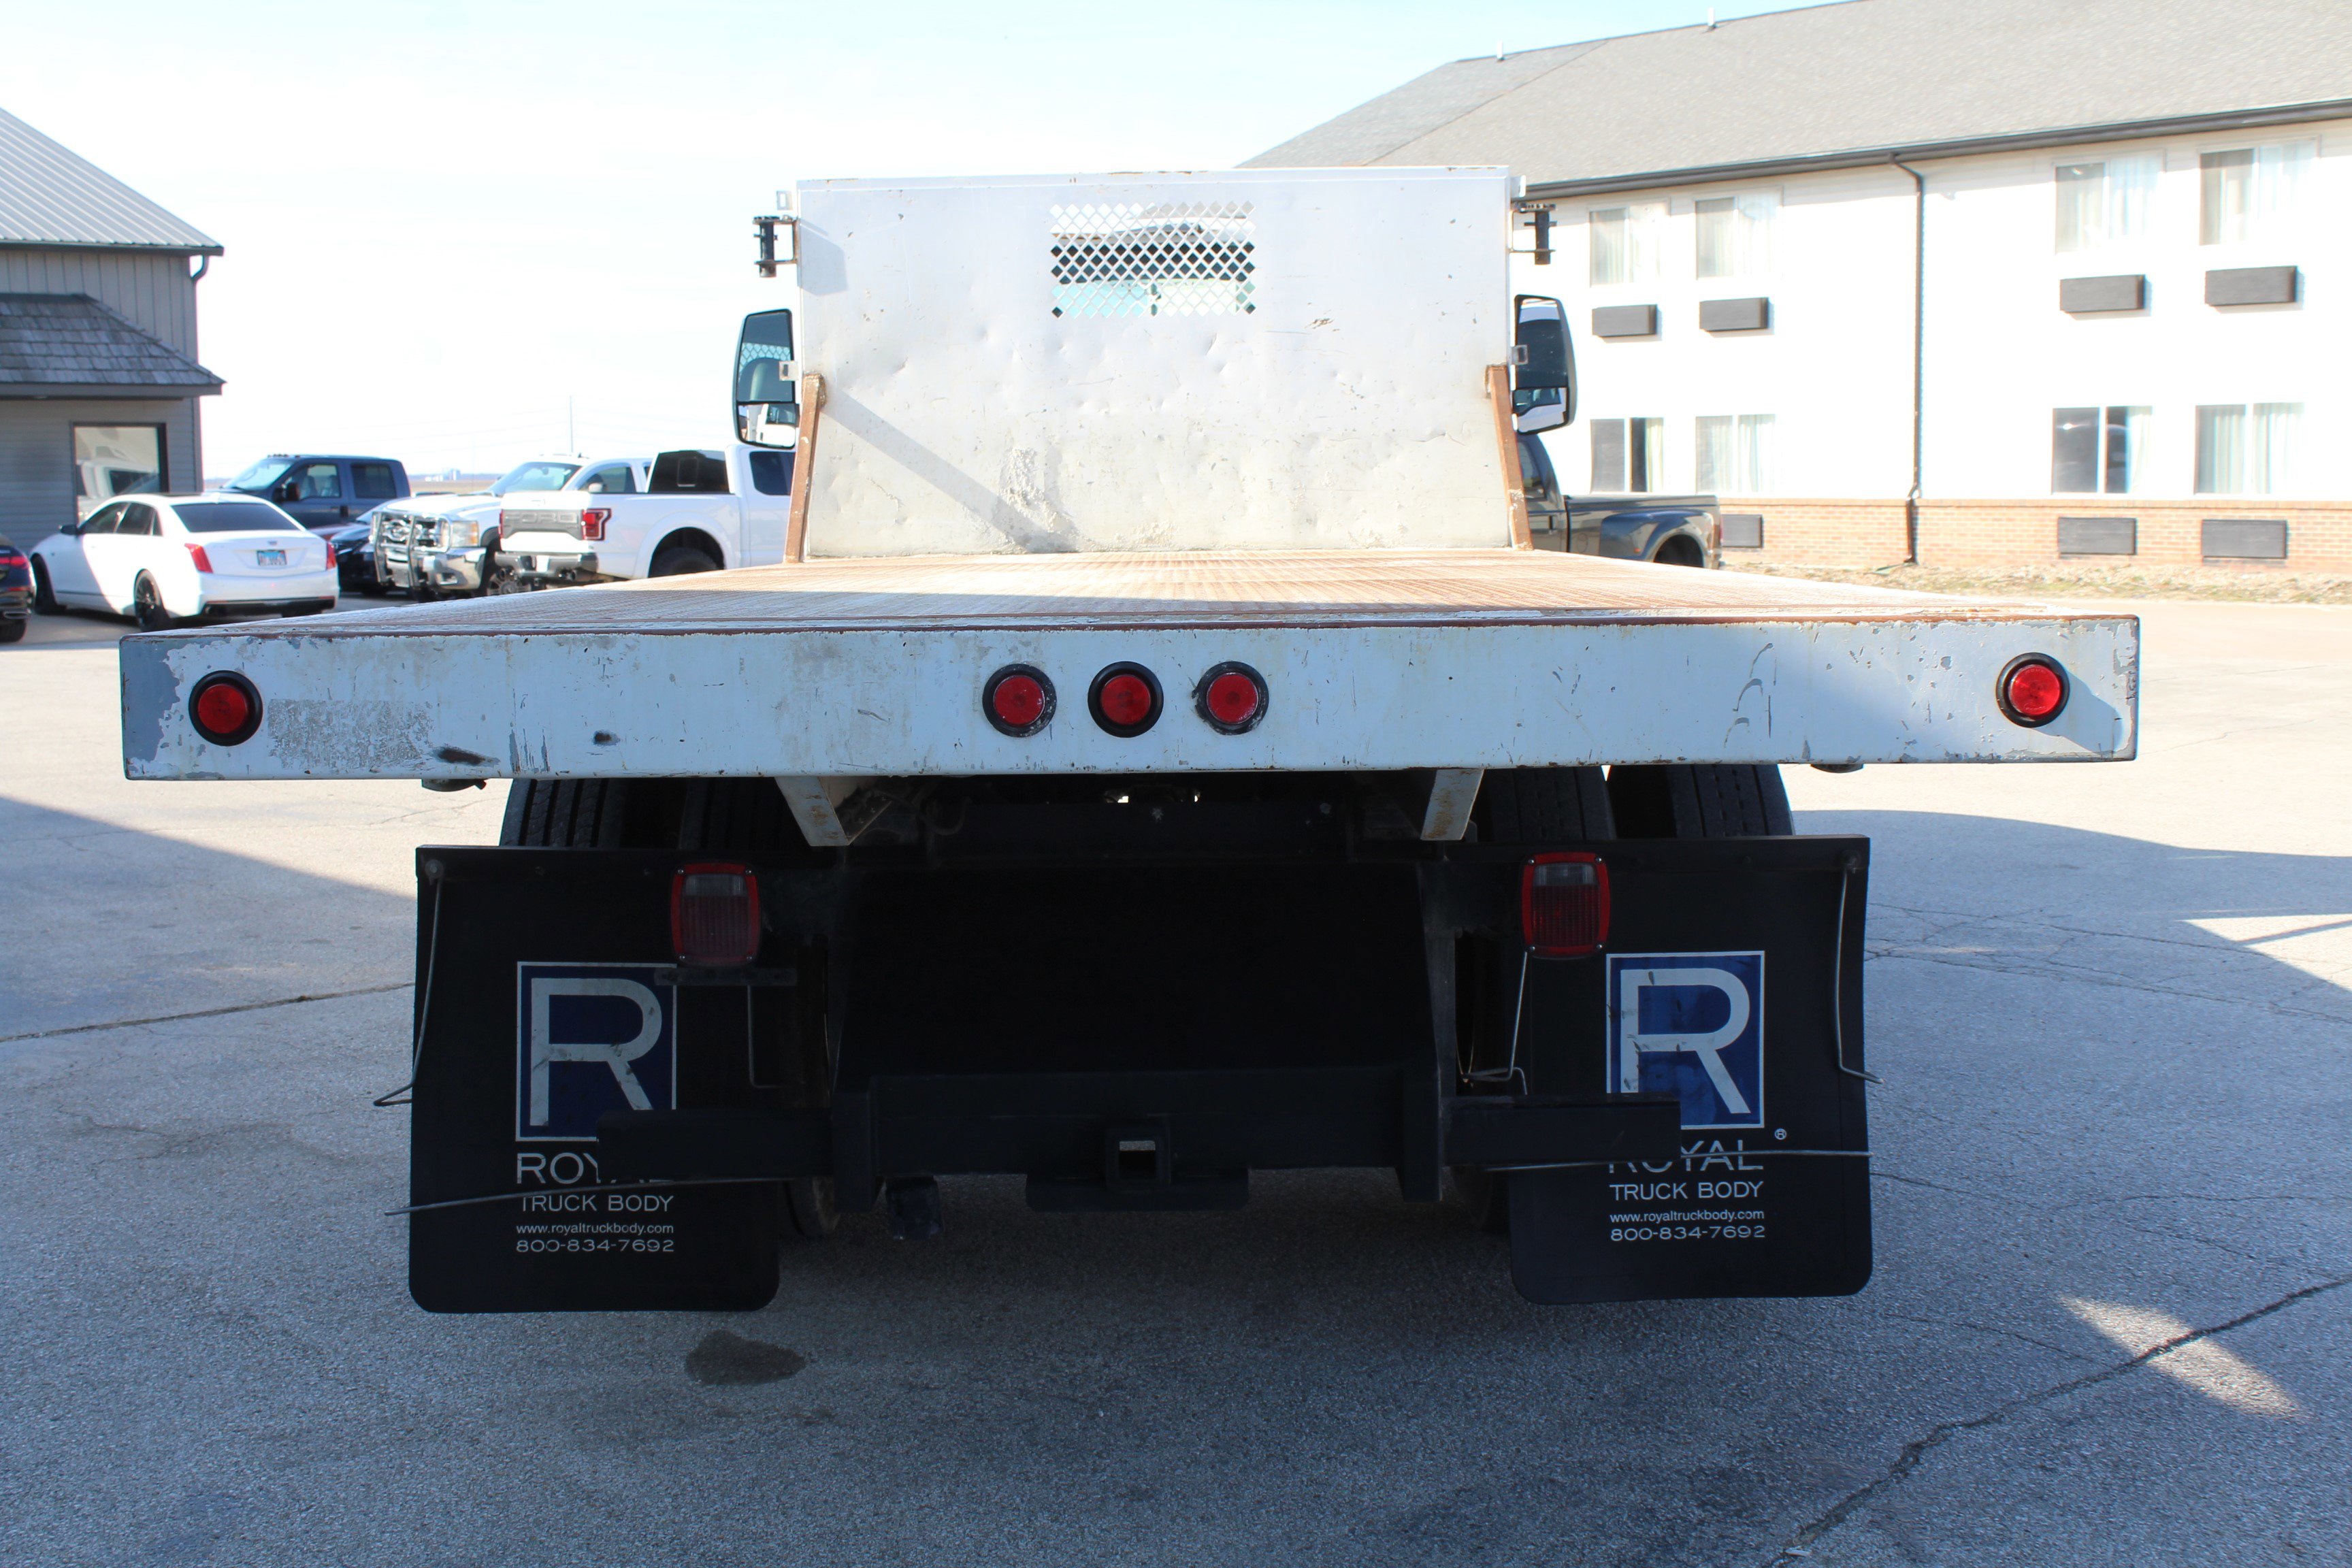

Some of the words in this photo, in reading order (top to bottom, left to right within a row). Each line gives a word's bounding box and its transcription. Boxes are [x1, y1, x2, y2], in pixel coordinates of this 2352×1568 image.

[505, 512, 577, 523] FORD
[1620, 968, 1751, 1114] R
[530, 978, 662, 1126] R
[1609, 1182, 1688, 1201] TRUCK
[1697, 1181, 1764, 1198] BODY
[608, 1194, 674, 1212] BODY
[1610, 1209, 1765, 1224] www.royaltruckbody.com
[516, 1223, 674, 1236] www.royaltruckbody.com
[1610, 1225, 1765, 1242] 800-834-7692
[516, 1239, 674, 1253] 800-834-7692
